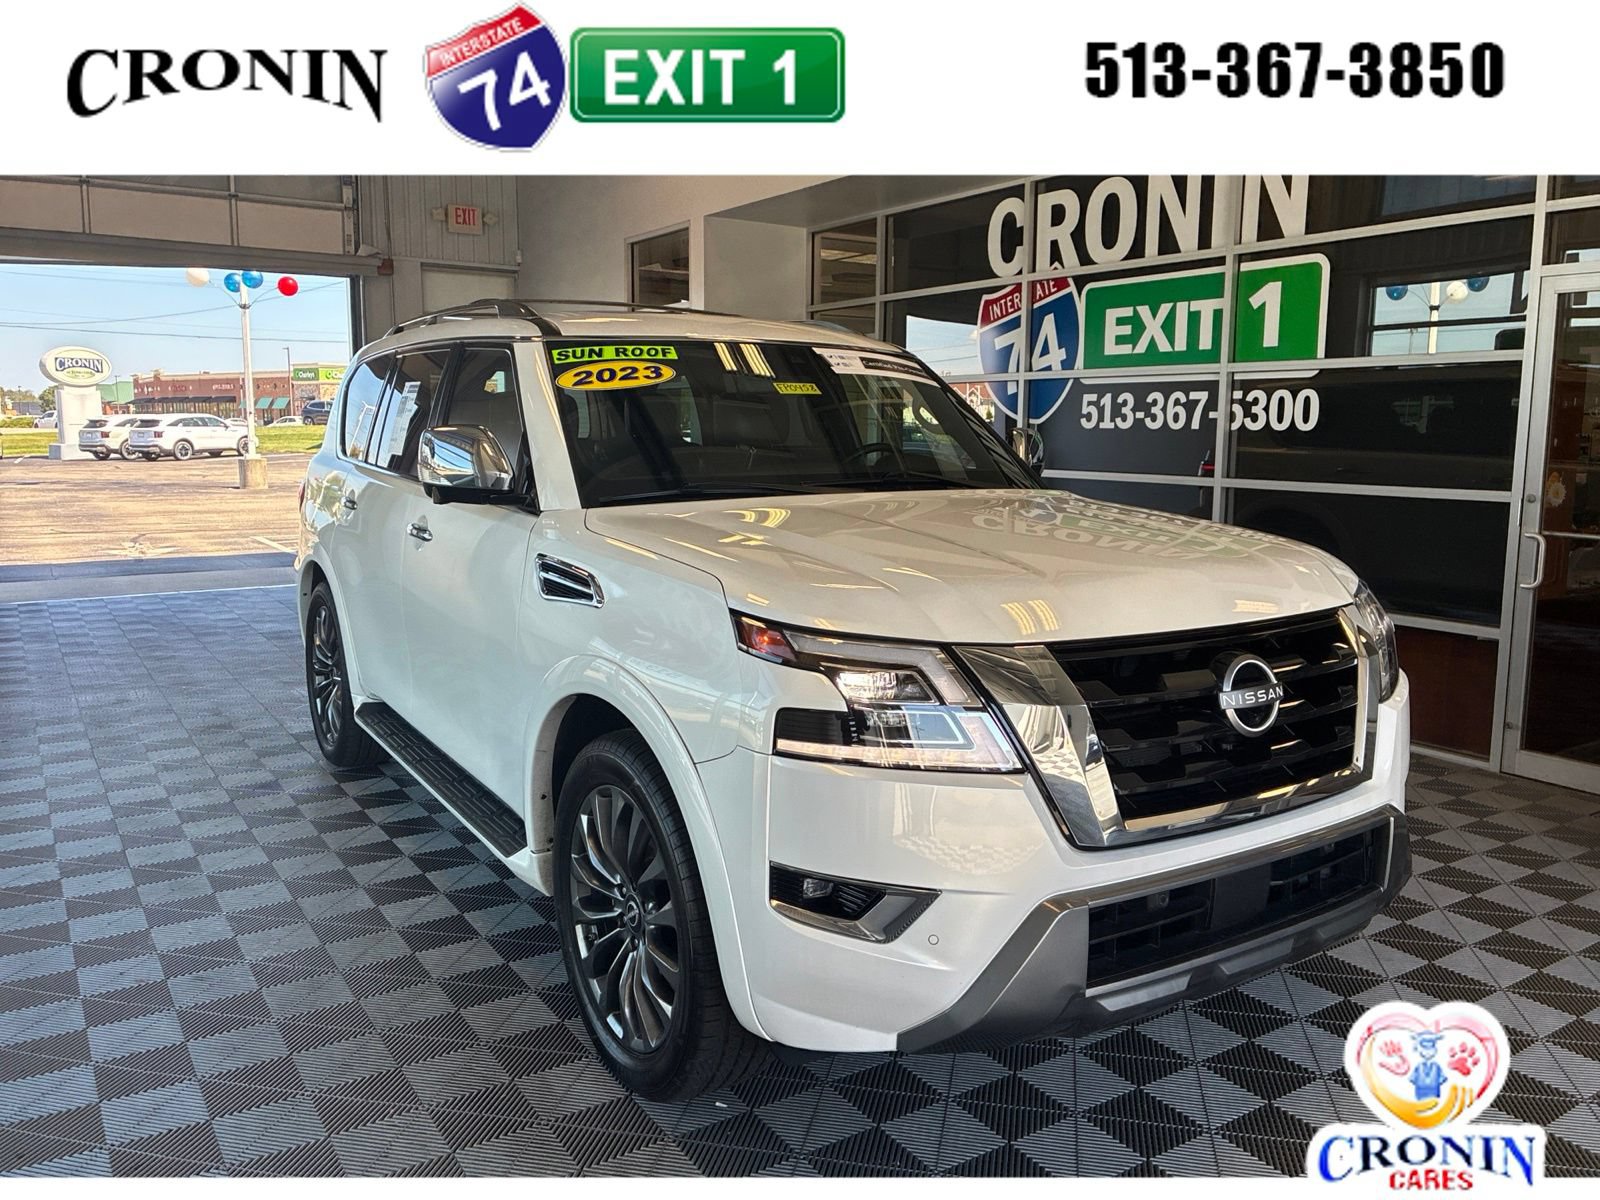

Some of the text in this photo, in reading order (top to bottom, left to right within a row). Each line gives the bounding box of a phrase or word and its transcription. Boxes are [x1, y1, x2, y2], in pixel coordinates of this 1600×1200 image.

[454, 207, 477, 226] EXIT
[987, 175, 1309, 278] CRONIN
[989, 279, 1058, 321] INTERATE
[1103, 281, 1283, 355] EXIT 1
[56, 357, 103, 373] CRONIN
[556, 347, 672, 361] SUN ROOF
[993, 313, 1067, 395] 74
[571, 366, 664, 387] 2023
[1080, 388, 1320, 431] 513-367-5300
[1222, 685, 1284, 706] NISSAN
